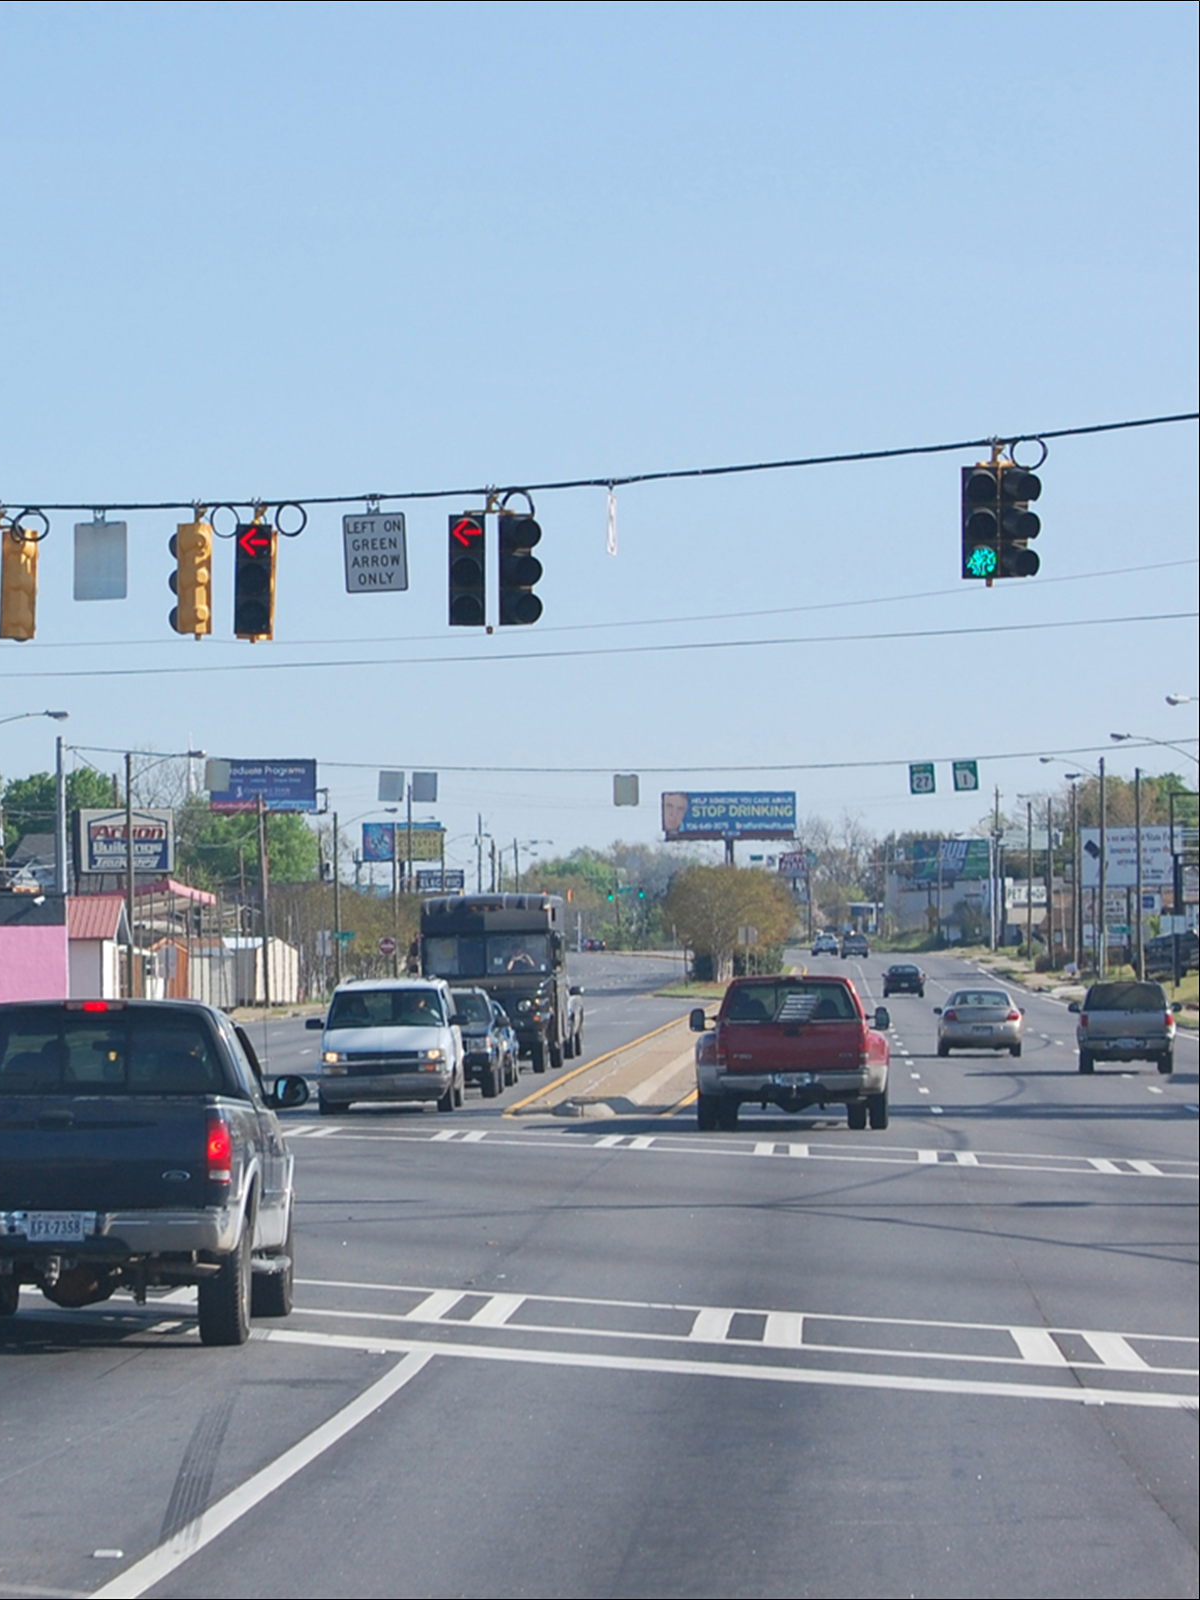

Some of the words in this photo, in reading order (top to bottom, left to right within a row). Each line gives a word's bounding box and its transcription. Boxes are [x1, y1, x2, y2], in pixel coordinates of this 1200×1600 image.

[346, 521, 375, 534] LEFT
[383, 520, 401, 532] ON
[352, 538, 397, 551] GREEN
[351, 555, 400, 568] ARROW
[358, 572, 394, 585] ONLY
[264, 765, 306, 776] Programs
[916, 776, 929, 788] 27
[692, 805, 726, 817] STOP
[729, 805, 793, 817] DRINKING
[1007, 888, 1022, 899] PET
[1028, 888, 1046, 899] HOP
